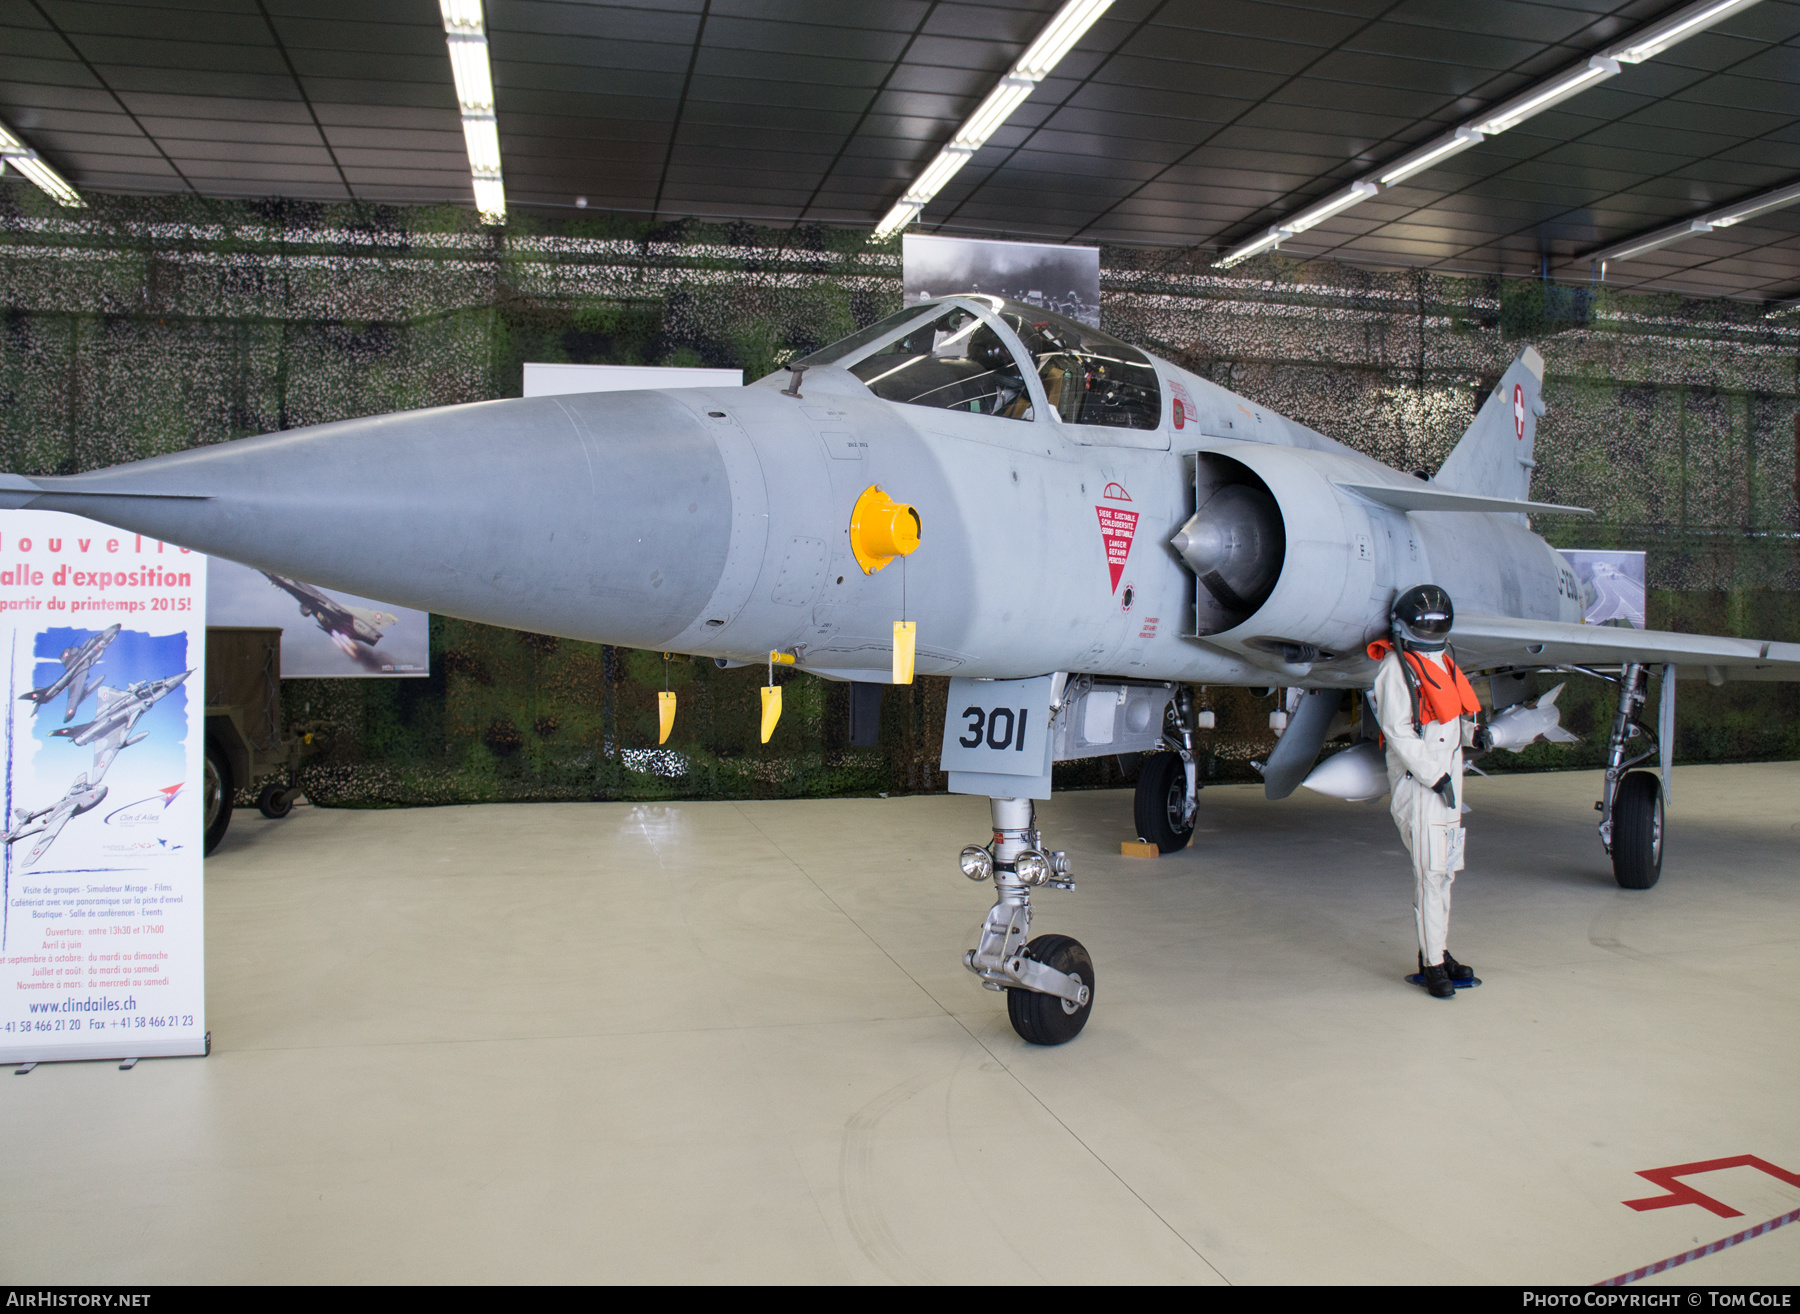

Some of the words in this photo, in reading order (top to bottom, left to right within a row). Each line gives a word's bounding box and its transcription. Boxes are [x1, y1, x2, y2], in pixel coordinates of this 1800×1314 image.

[1098, 509, 1112, 518] SIEGE
[0, 564, 44, 586] alle
[52, 564, 191, 591] d'exposition
[0, 596, 42, 613] partir
[47, 596, 66, 611] du
[71, 596, 146, 613] printemps
[150, 597, 192, 611] 2015!
[959, 706, 1028, 752] 301
[22, 886, 42, 894] Visite
[43, 886, 52, 894] de
[53, 886, 80, 895] groupes
[86, 884, 122, 894] Simulateur
[124, 884, 148, 894] Mirage
[154, 884, 172, 892] Films
[76, 898, 120, 906] panoramique
[134, 896, 140, 904] la
[142, 896, 157, 906] piste
[159, 895, 183, 904] d'envol
[32, 910, 62, 919] Boutique
[69, 910, 86, 918] Salle
[97, 909, 135, 917] conférences
[142, 908, 163, 916] Events
[46, 928, 84, 936] Ouverture:
[109, 926, 131, 935] 13h30
[142, 925, 164, 934] 17h00
[42, 940, 59, 949] Avril
[61, 941, 66, 949] à
[67, 941, 82, 950] juin
[8, 954, 46, 965] septembre
[48, 954, 53, 962] à
[55, 953, 84, 962] octobre:
[88, 953, 97, 962] du
[99, 952, 121, 961] mardi
[134, 951, 168, 960] dimanche
[32, 966, 54, 976] Juillet
[64, 967, 84, 975] août:
[88, 966, 97, 975] du
[99, 965, 121, 974] mardi
[134, 964, 160, 973] samedi
[17, 980, 54, 990] Novembre
[56, 981, 61, 989] à
[88, 979, 97, 988] du
[99, 978, 131, 987] mercredi
[143, 977, 169, 986] samedi
[29, 995, 136, 1013] www.clindailes.ch
[20, 1021, 32, 1032] 58
[34, 1020, 52, 1031] 466
[54, 1020, 66, 1031] 21
[69, 1019, 81, 1030] 20
[89, 1018, 105, 1030] Fax
[110, 1017, 131, 1028] +41
[134, 1017, 146, 1028] 58
[148, 1016, 166, 1027] 466
[168, 1015, 178, 1026] 21
[182, 1015, 194, 1026] 23
